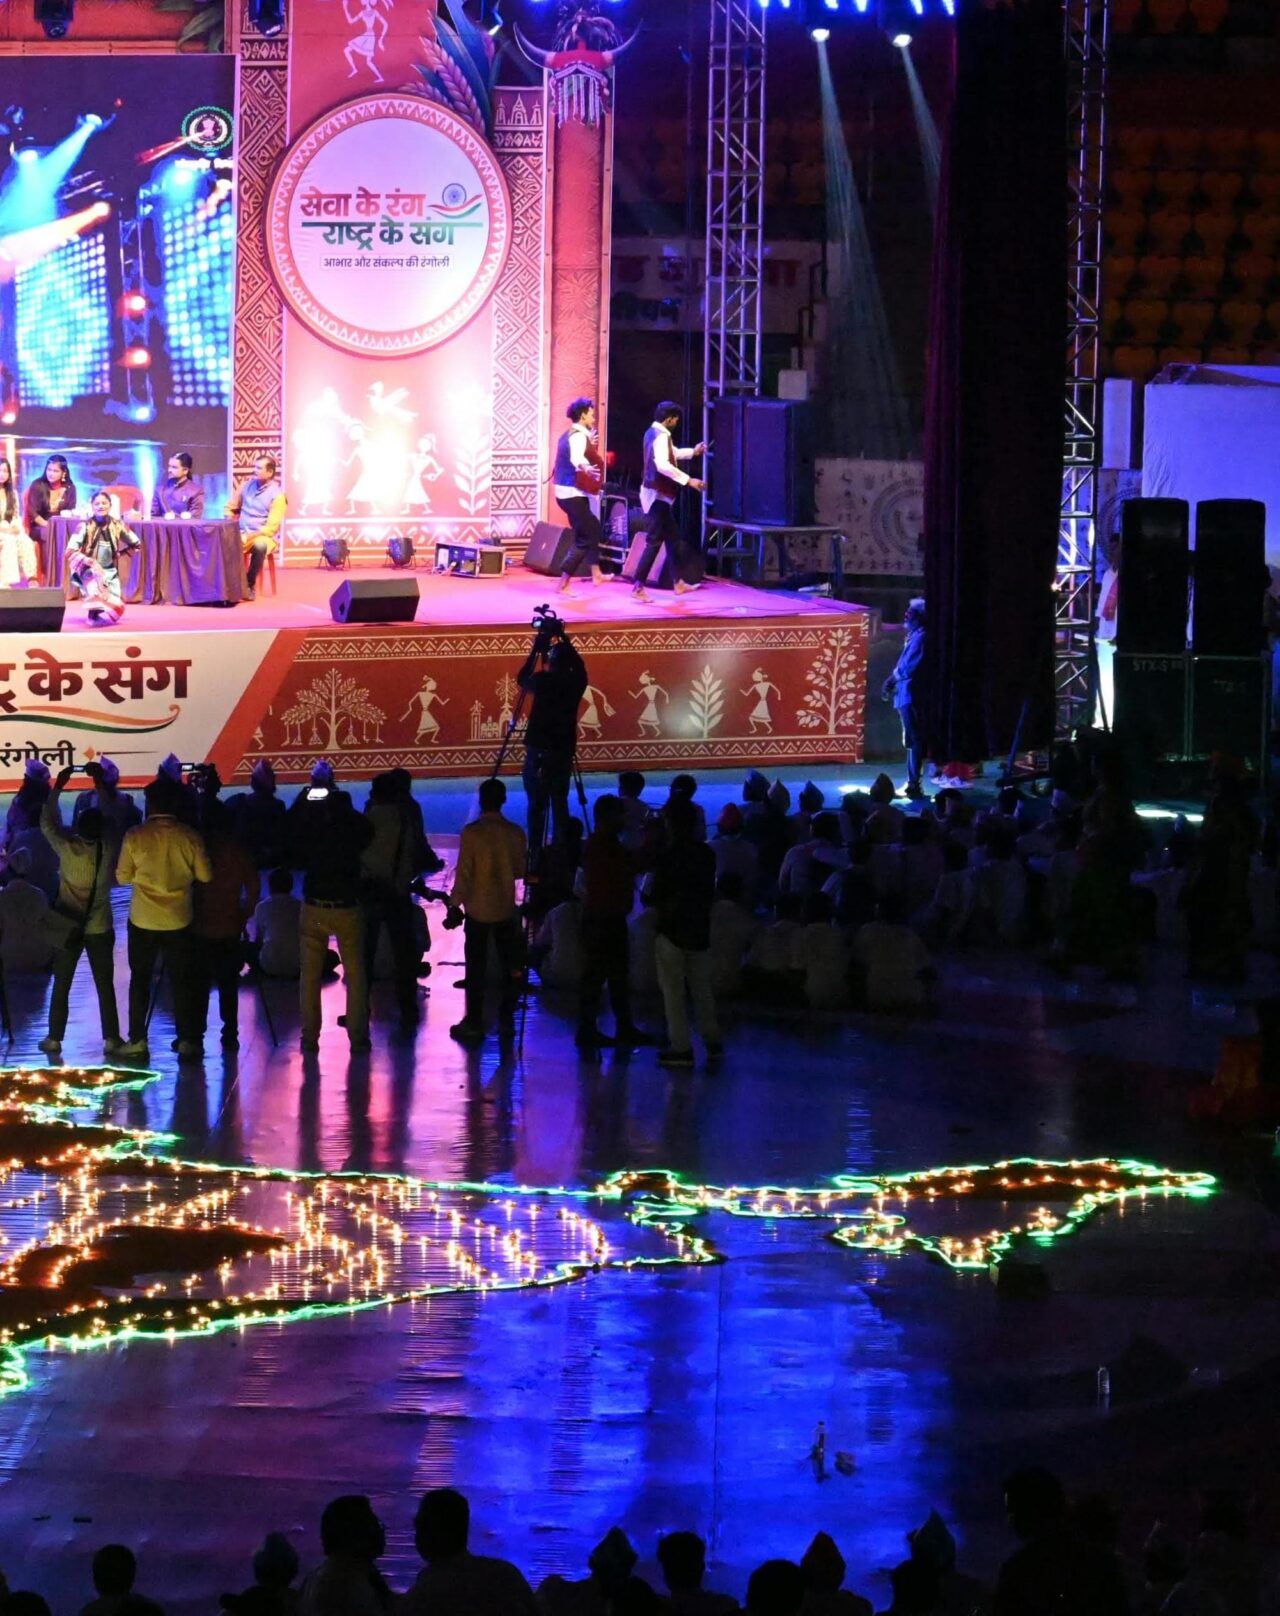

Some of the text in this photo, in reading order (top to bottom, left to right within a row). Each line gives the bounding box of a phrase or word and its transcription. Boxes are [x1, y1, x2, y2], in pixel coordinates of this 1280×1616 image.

[300, 186, 427, 217] सेवा के रंग
[317, 214, 457, 251] राष्ट्र के संग
[323, 255, 450, 268] आभार और संकल्प की रंगोली
[24, 648, 83, 702] के
[91, 645, 192, 704] संग
